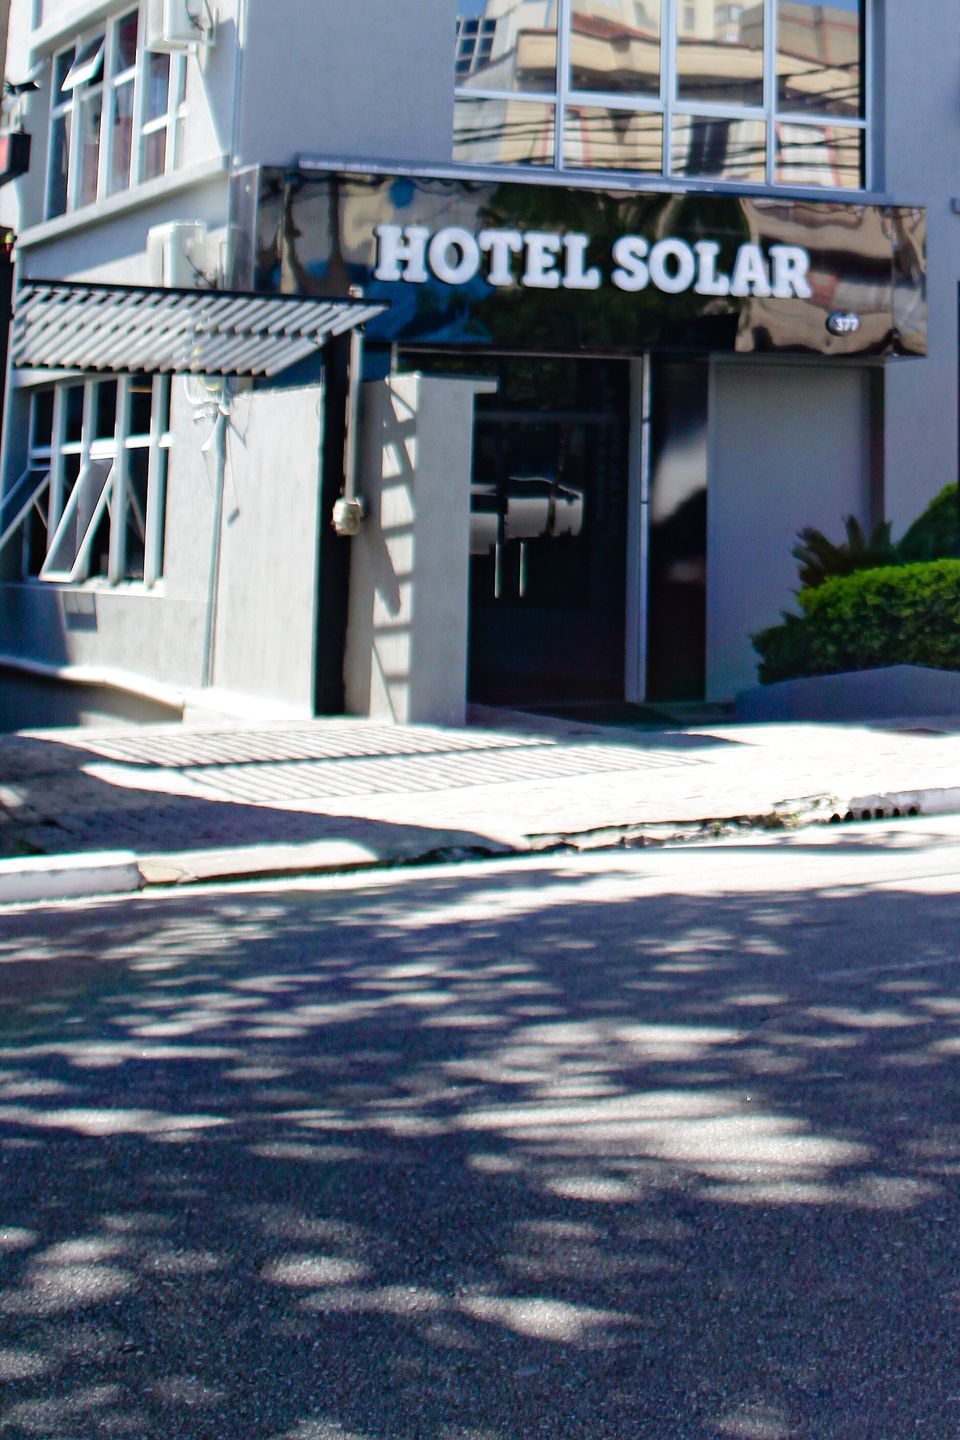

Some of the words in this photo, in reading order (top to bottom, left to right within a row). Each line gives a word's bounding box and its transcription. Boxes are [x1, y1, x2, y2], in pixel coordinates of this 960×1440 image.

[374, 225, 600, 290] HOTEL
[611, 235, 813, 298] SOLAR
[835, 318, 859, 332] 377
